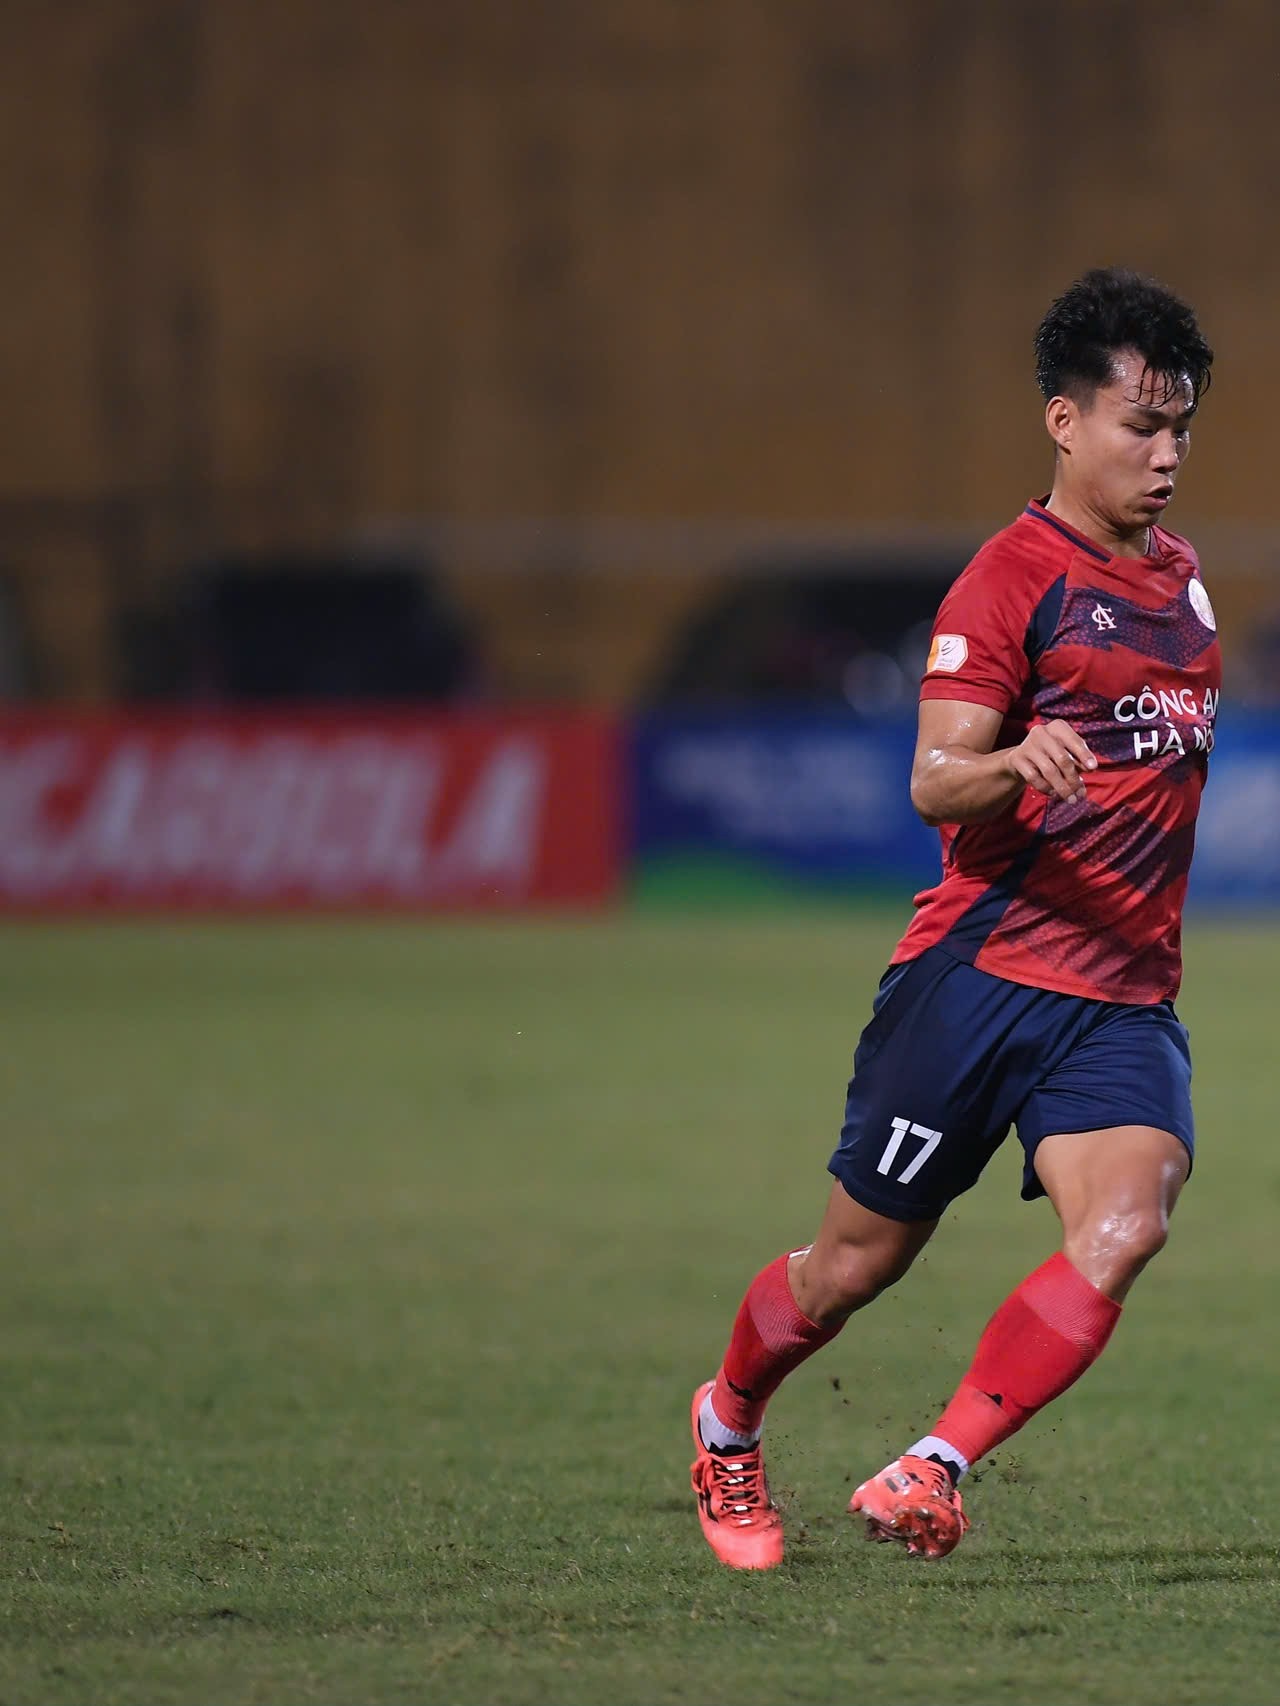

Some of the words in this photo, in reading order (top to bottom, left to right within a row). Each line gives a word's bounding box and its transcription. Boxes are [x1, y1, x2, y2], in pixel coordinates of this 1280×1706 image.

[1114, 685, 1198, 722] CÔNG
[1133, 721, 1186, 759] HÀ
[876, 1116, 944, 1185] 17
